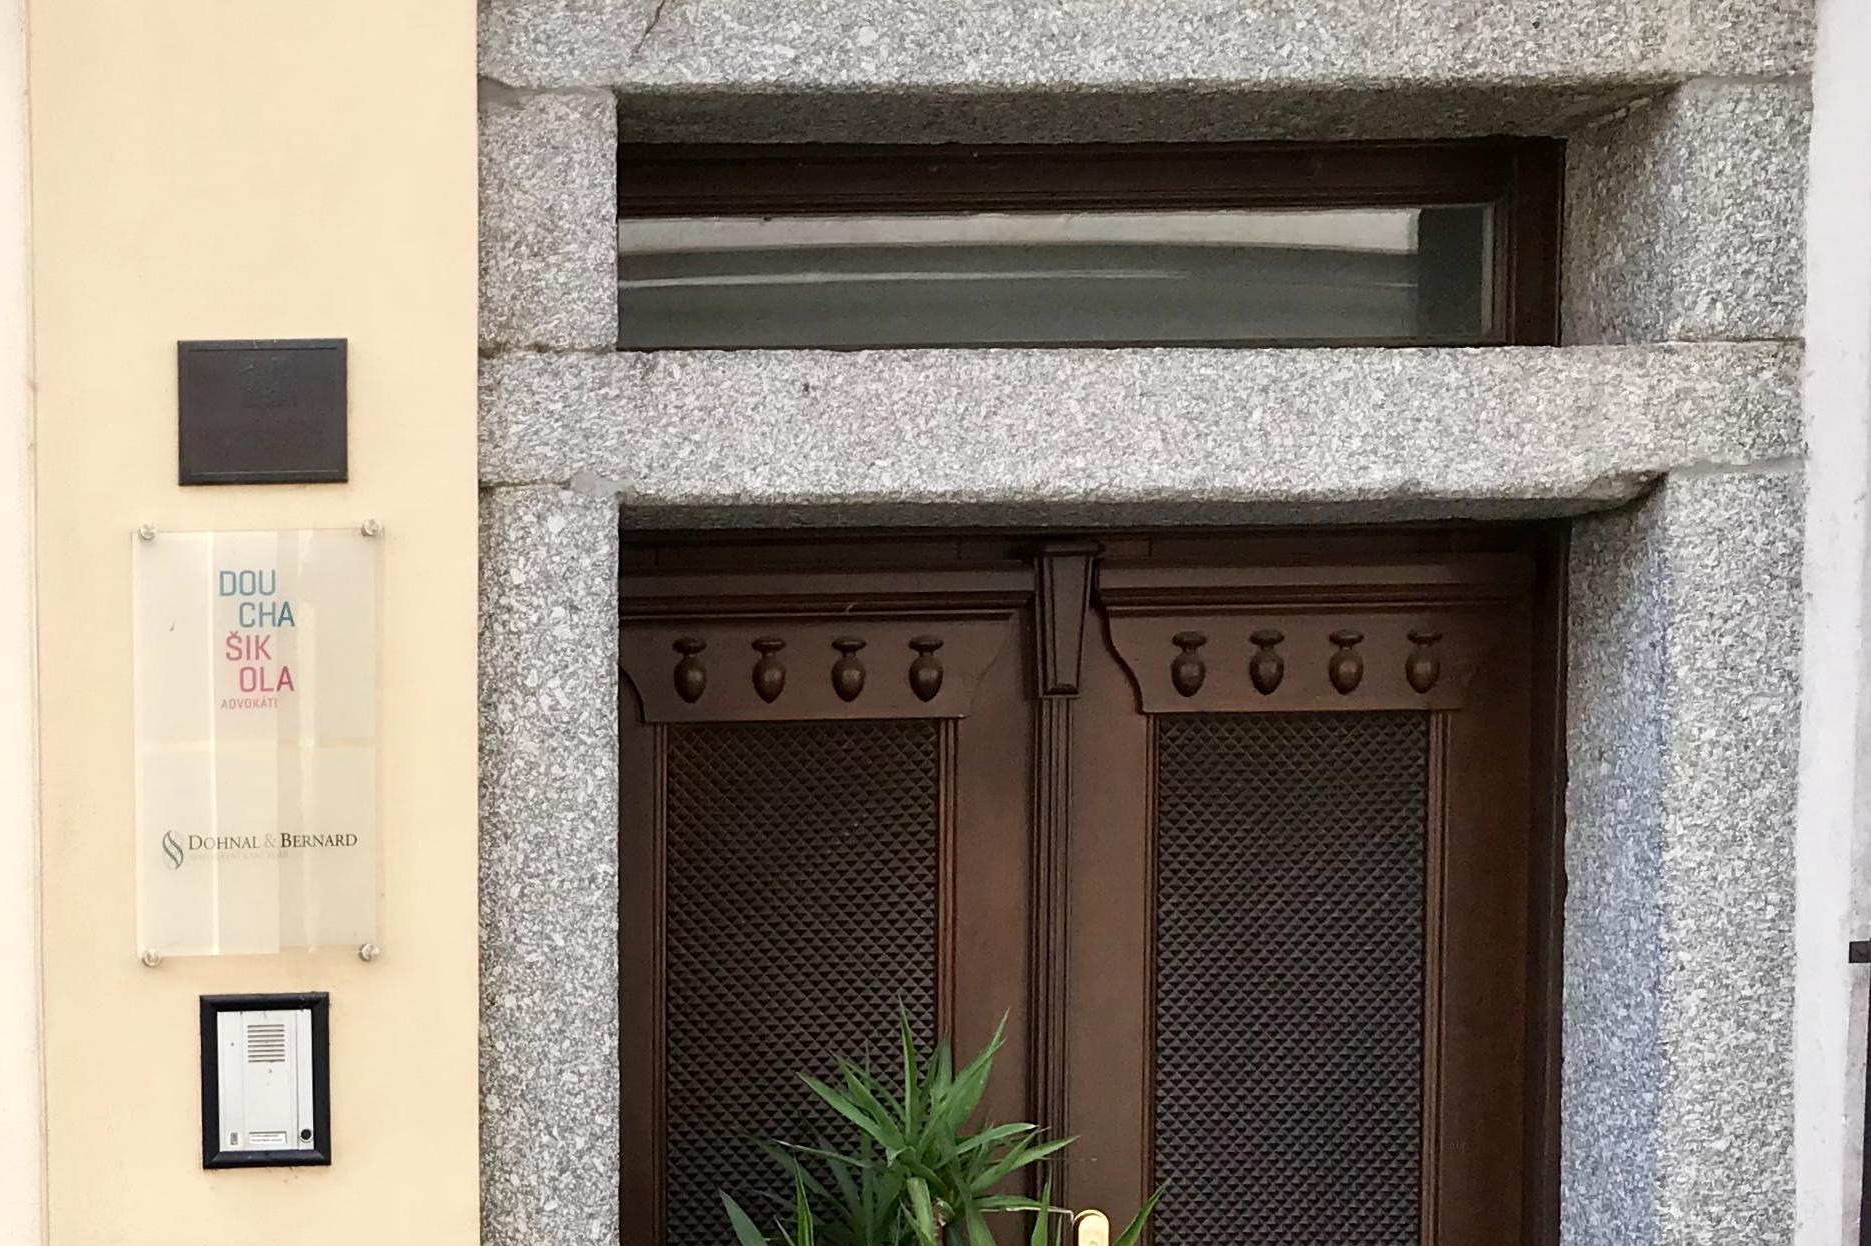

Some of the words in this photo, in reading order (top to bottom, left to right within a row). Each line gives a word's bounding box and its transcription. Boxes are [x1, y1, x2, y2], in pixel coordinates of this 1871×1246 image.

[219, 569, 276, 596] DOU
[239, 601, 296, 628] CHA
[225, 630, 272, 661] ŠIK
[239, 665, 294, 692] OLA
[280, 832, 358, 848] BERNARD
